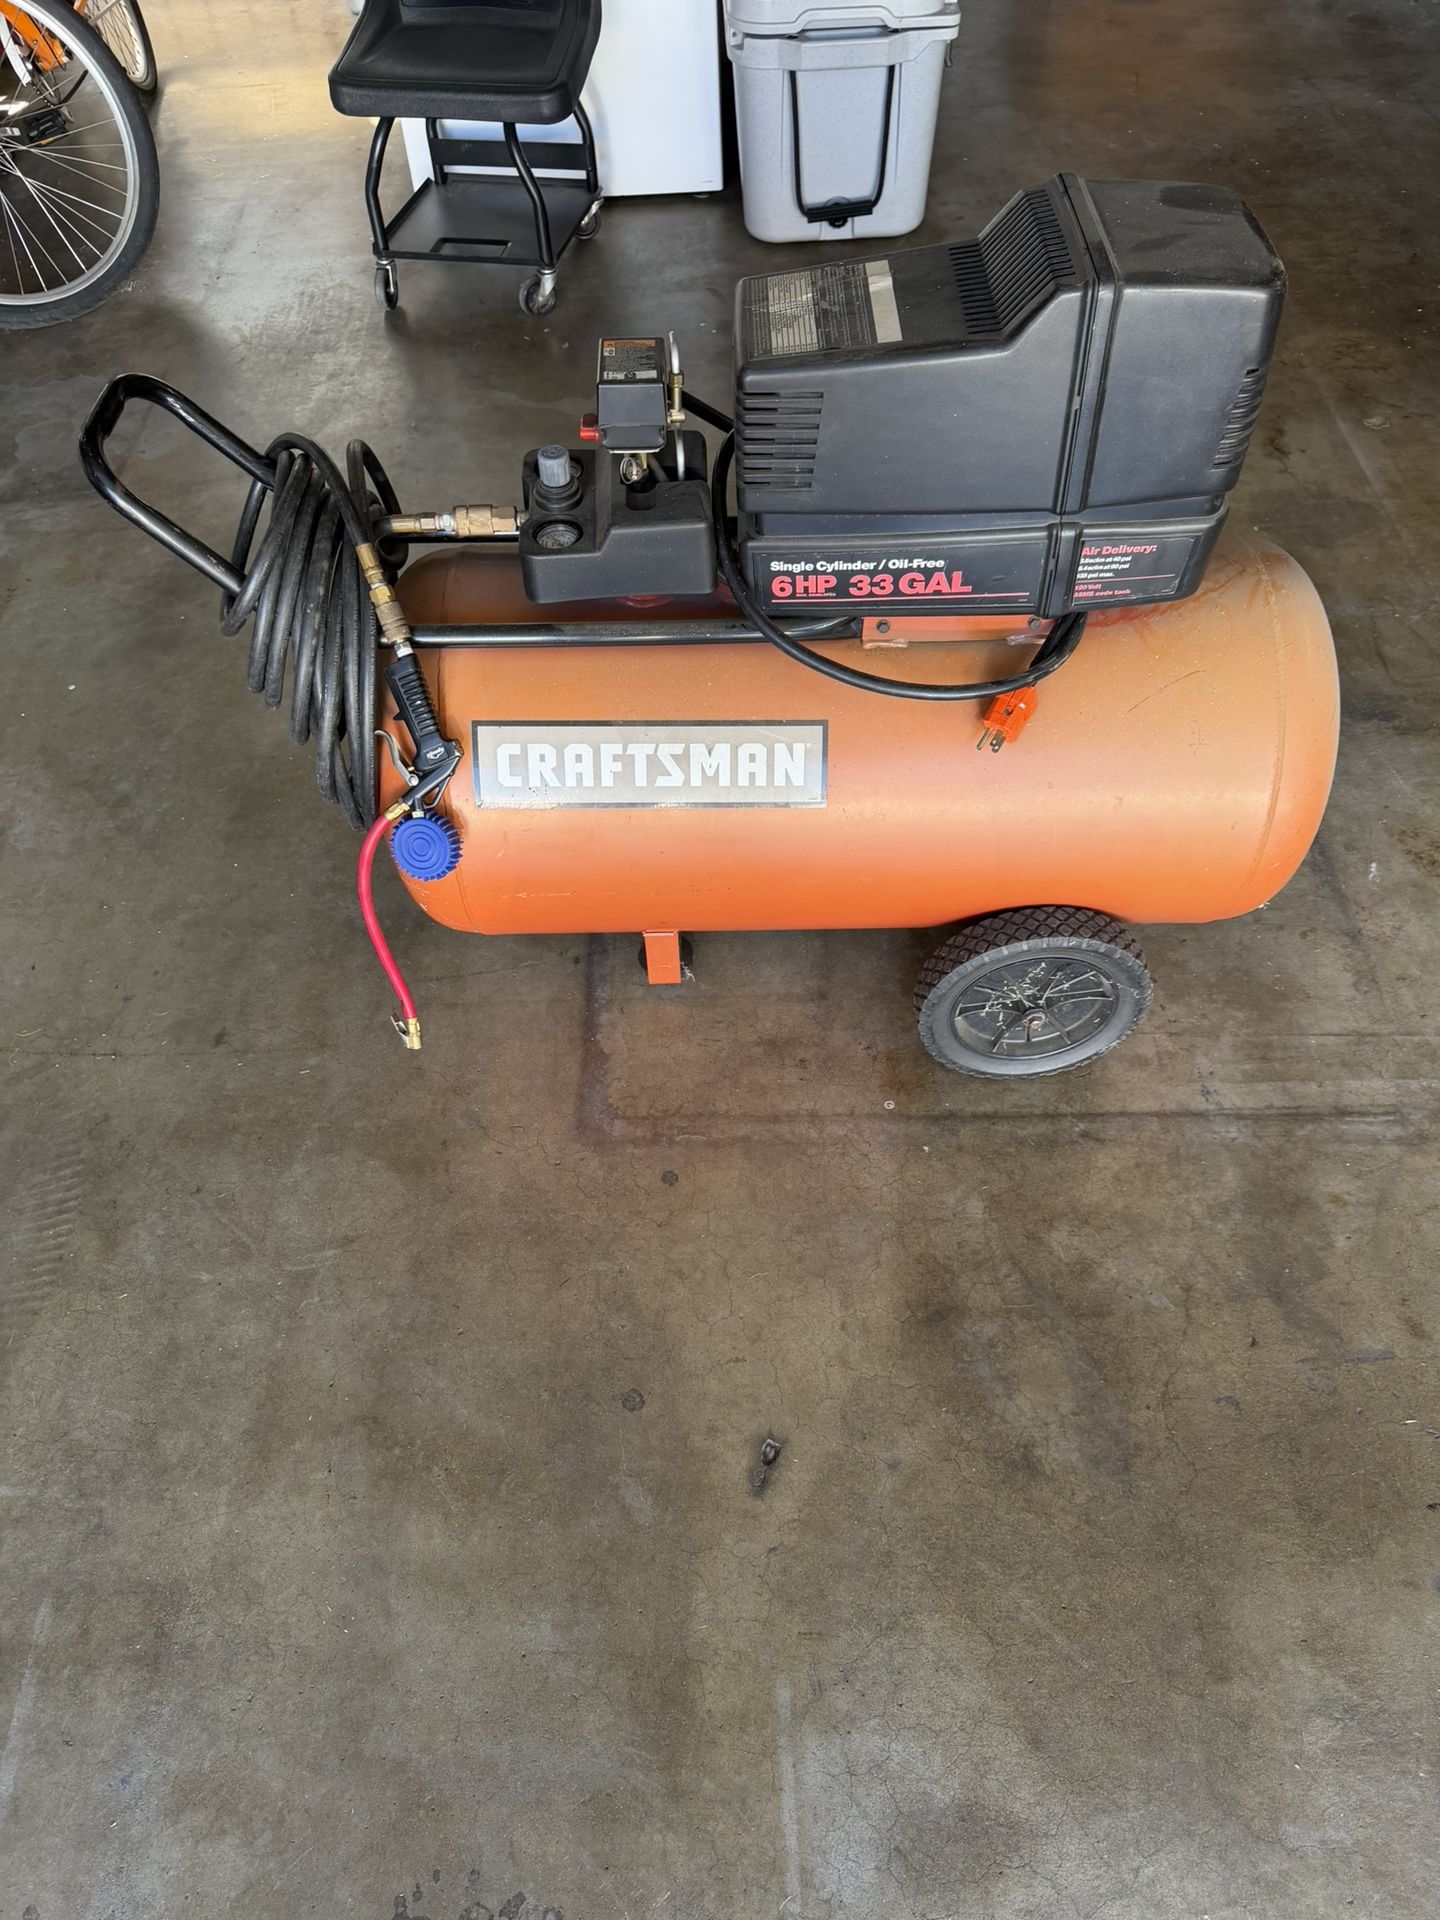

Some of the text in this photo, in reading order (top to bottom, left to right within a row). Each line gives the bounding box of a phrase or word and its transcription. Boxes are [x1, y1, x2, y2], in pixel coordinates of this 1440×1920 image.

[1082, 545, 1157, 556] Air Delivery:
[769, 558, 946, 573] Single Cylinder / Oil-Free
[771, 571, 973, 598] 6 HP 33 GAL
[496, 742, 806, 788] CRAFTSMAN
